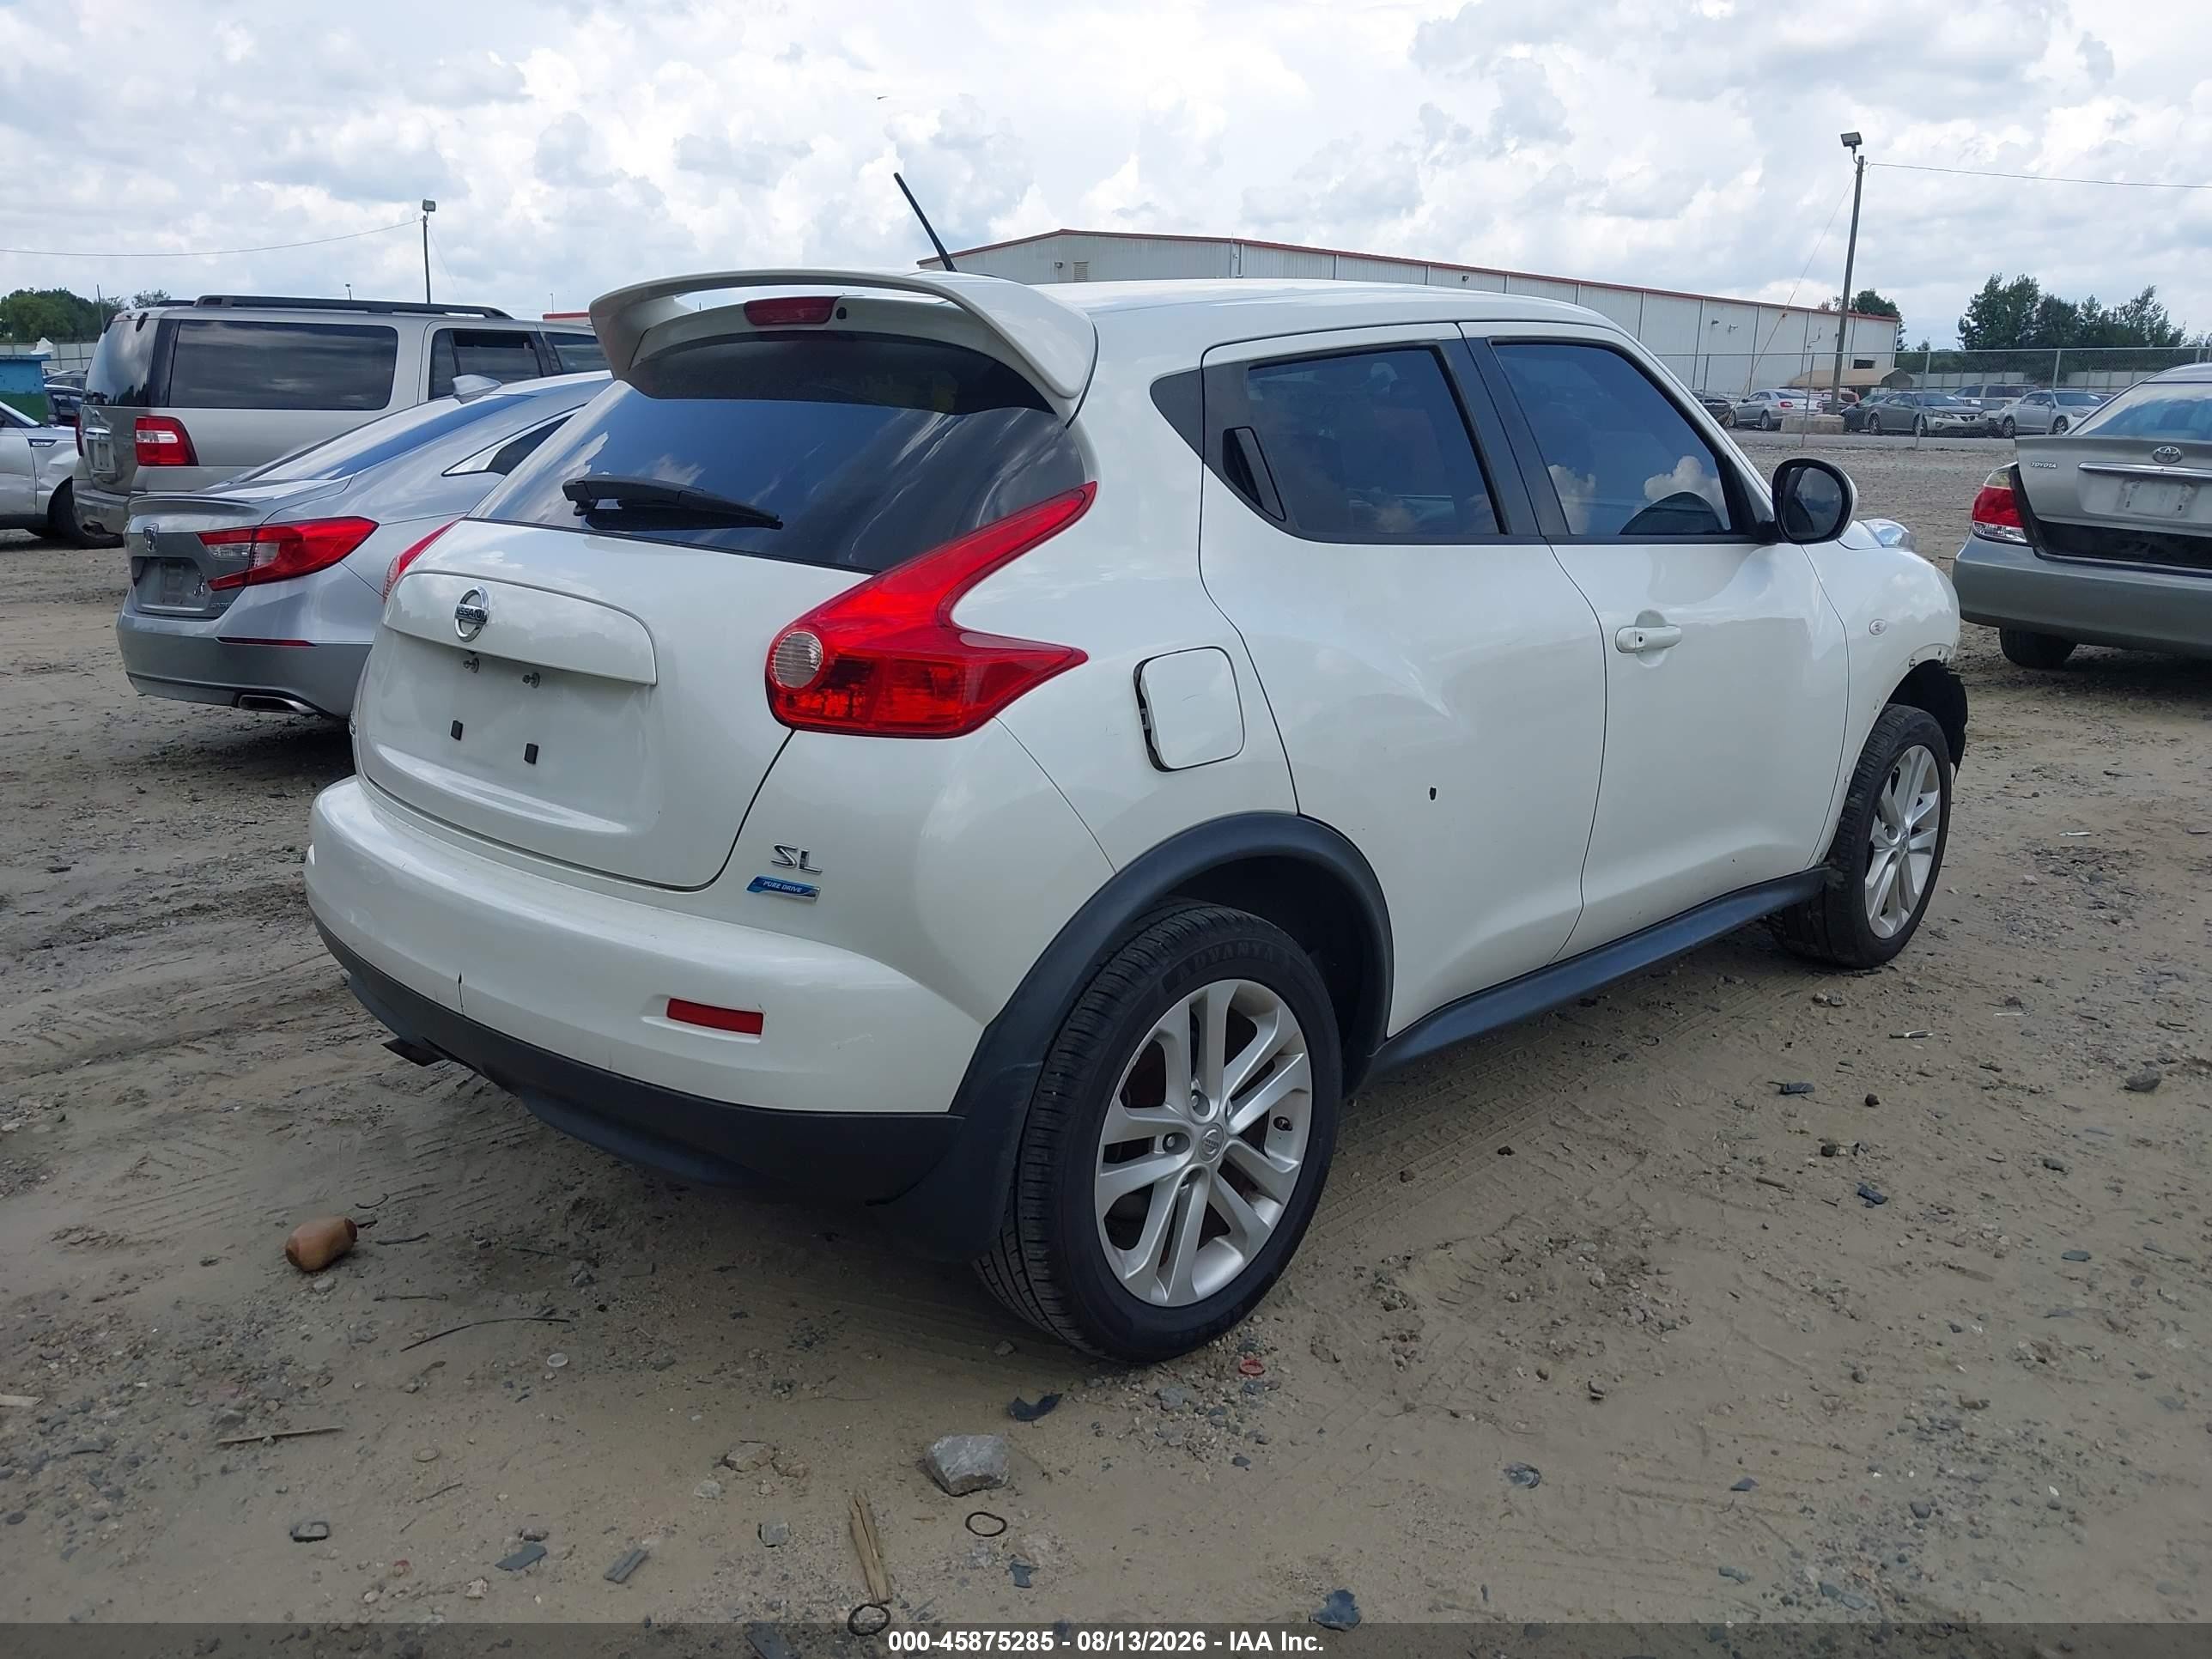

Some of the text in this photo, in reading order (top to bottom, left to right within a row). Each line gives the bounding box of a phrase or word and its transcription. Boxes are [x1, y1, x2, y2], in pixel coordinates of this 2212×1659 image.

[770, 842, 823, 875] SL
[763, 879, 803, 893] PURE DRIVE
